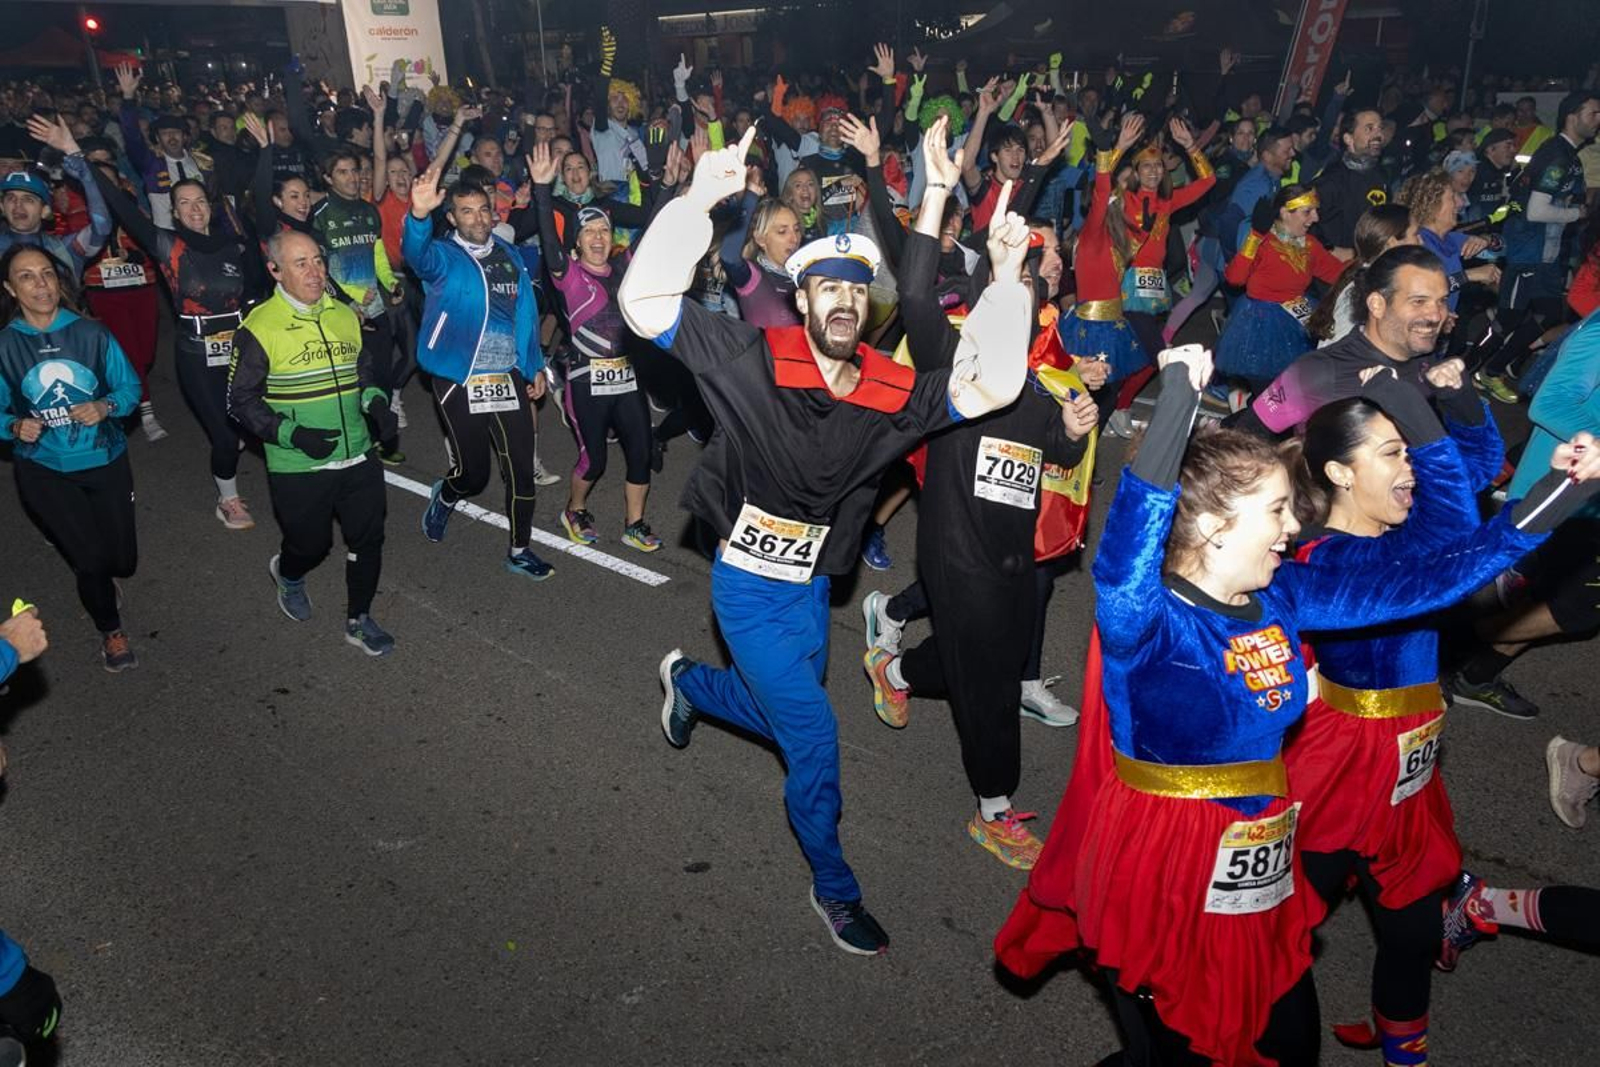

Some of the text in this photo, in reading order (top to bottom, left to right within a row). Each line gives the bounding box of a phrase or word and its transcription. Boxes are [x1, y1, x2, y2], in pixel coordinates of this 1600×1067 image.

[331, 236, 352, 248] SAN
[104, 264, 140, 278] 7960
[1138, 275, 1163, 288] 6502
[595, 366, 631, 382] 9017
[473, 384, 512, 399] 5581
[985, 455, 1036, 486] 7029
[759, 516, 776, 531] 42
[740, 524, 814, 560] 5674
[1244, 664, 1292, 692] GIRL
[1247, 824, 1266, 842] 42
